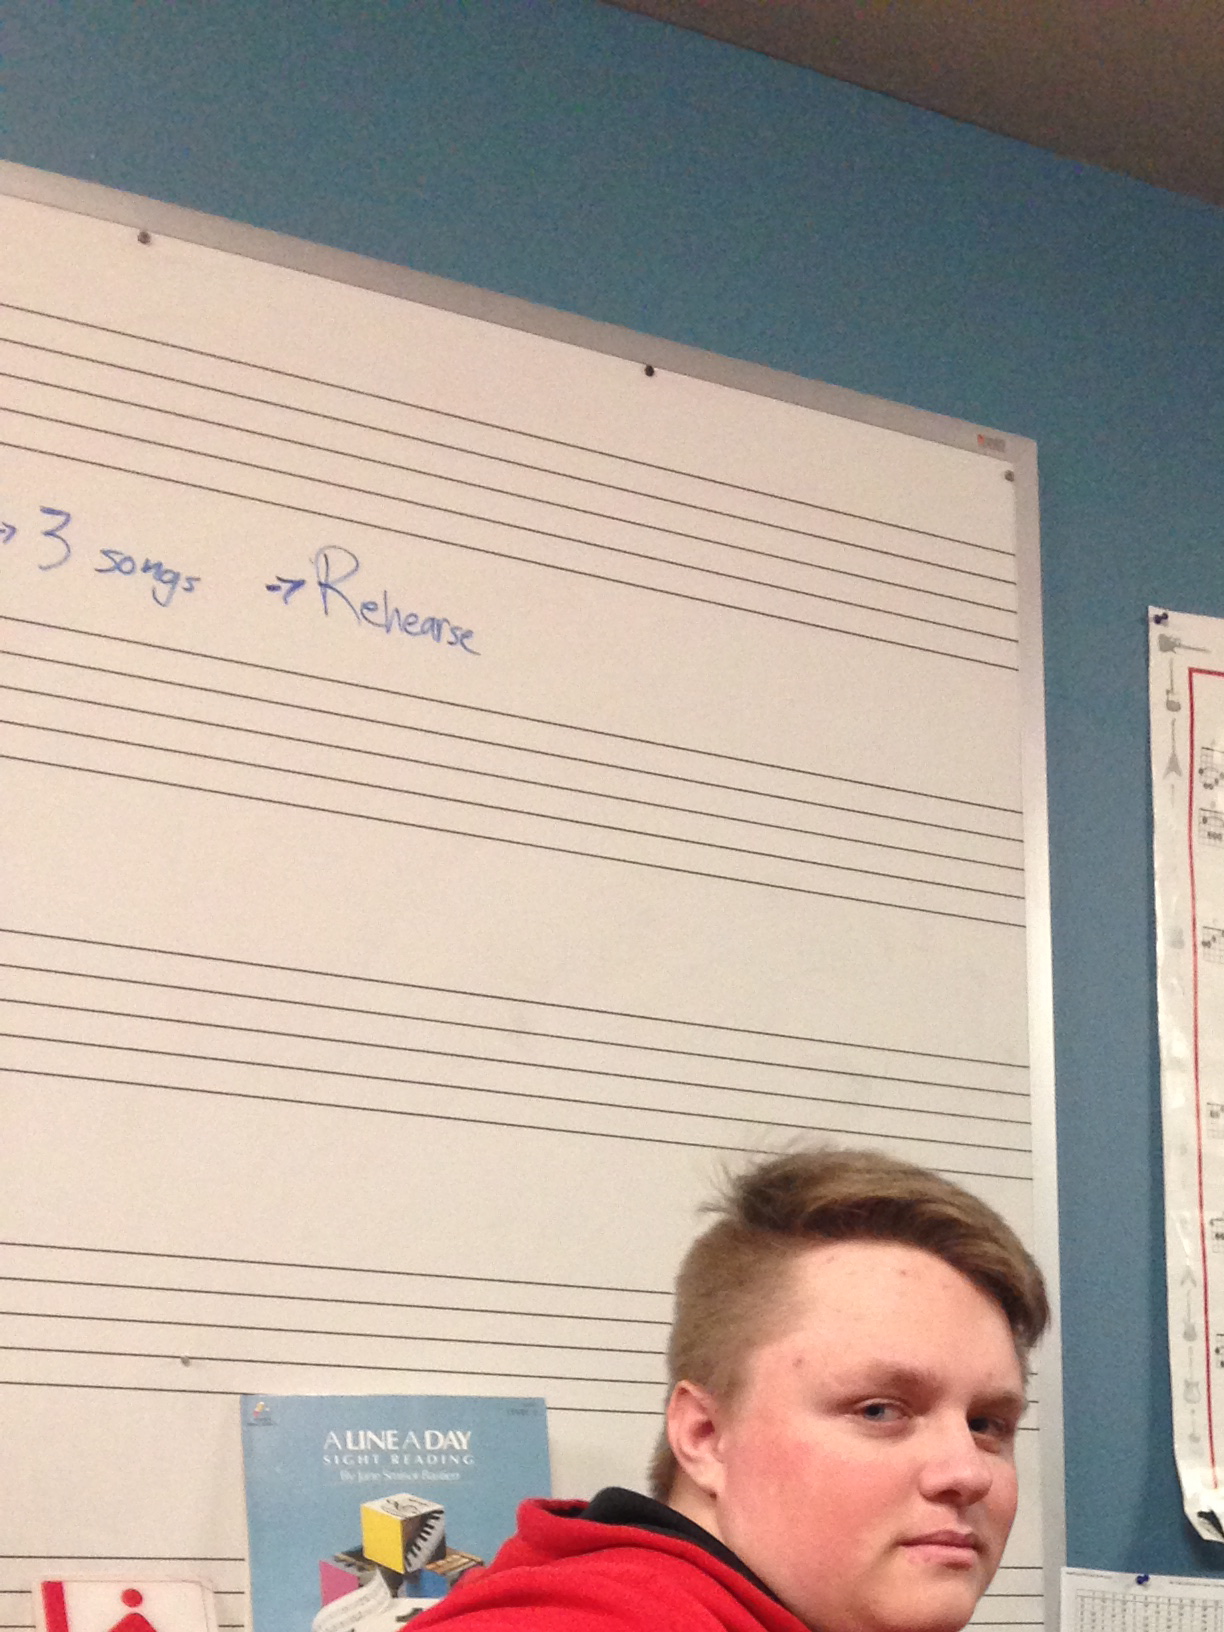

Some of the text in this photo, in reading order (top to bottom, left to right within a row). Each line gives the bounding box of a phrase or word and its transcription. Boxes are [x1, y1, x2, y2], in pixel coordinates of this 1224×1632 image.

[38, 506, 201, 607] 3 songs
[310, 544, 481, 657] Rehearse
[322, 1453, 476, 1466] SIGHT READING
[323, 1429, 471, 1451] A LINE A DAY
